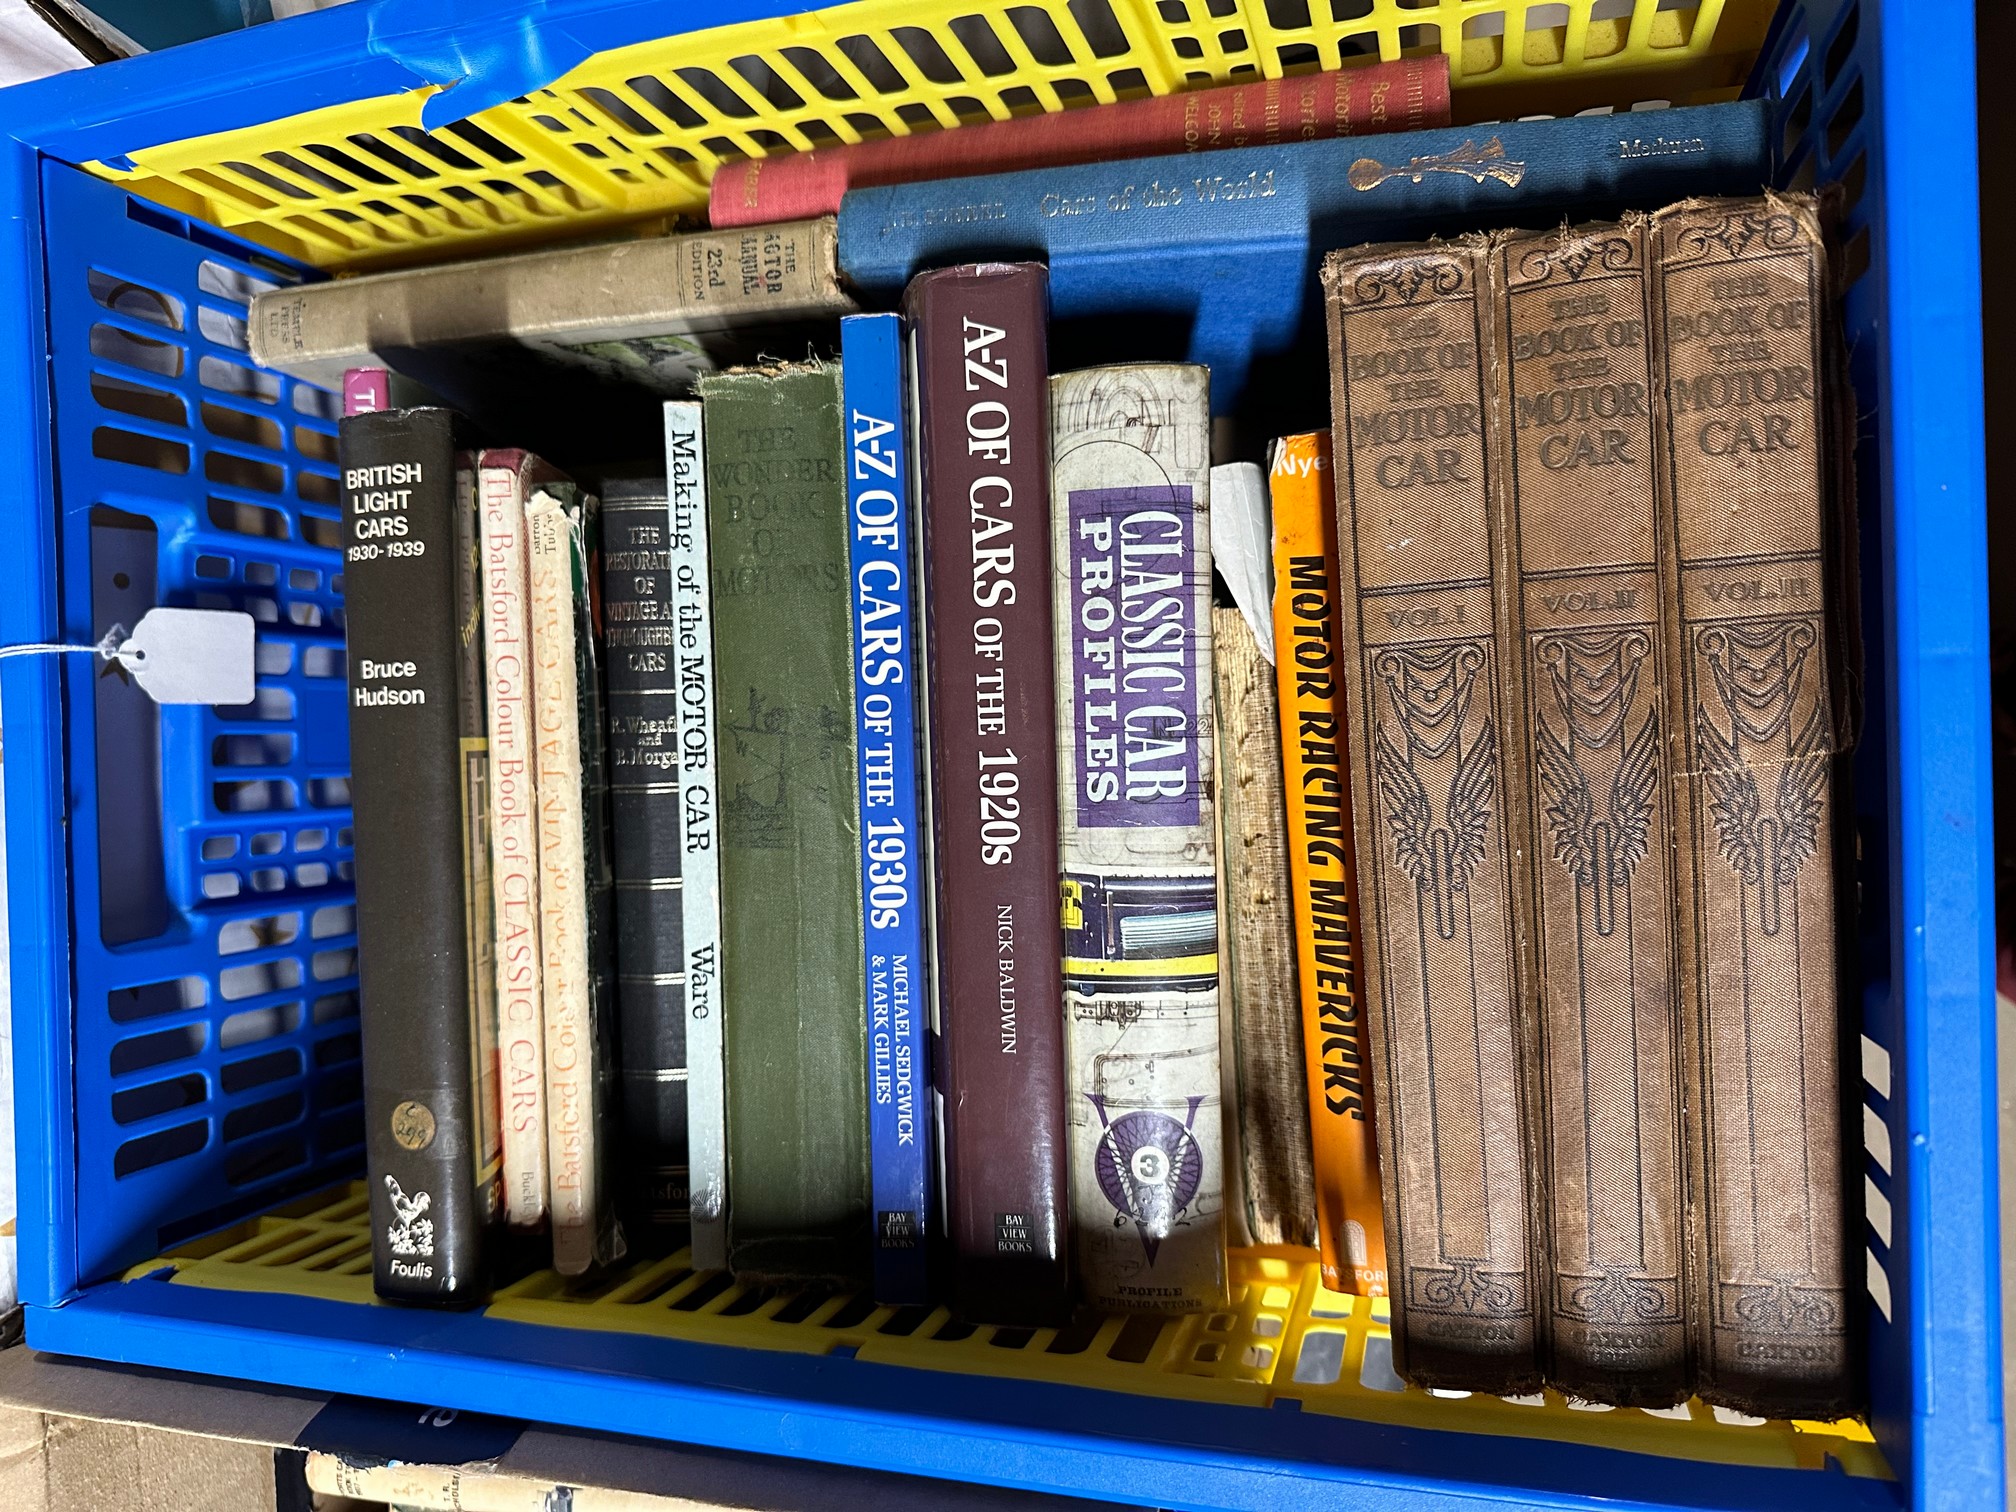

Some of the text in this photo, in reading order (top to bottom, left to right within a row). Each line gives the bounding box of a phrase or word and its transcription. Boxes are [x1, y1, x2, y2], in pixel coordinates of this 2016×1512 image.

[1300, 84, 1316, 141] Storie
[1335, 72, 1353, 137] Motori
[1370, 81, 1390, 126] Best
[1184, 96, 1199, 152] WELCO
[1040, 170, 1276, 219] Cars of the World
[692, 241, 705, 300] EDITION
[707, 249, 725, 288] 23rd
[785, 241, 796, 274] THE
[1711, 274, 1770, 300] THE
[1549, 294, 1609, 322] THE
[1670, 299, 1805, 344] BOOK OF
[1386, 316, 1441, 341] THE
[1515, 318, 1643, 361] BOOK OF
[963, 316, 1008, 391] A-Z
[1351, 340, 1473, 380] BOOK OF
[1549, 356, 1610, 382] THE
[1709, 340, 1773, 365] THE
[1388, 379, 1442, 402] THE
[1518, 382, 1649, 430] MOTOR
[1674, 366, 1814, 414] MOTOR
[737, 427, 796, 454] THE
[853, 408, 896, 480] A-Z
[966, 401, 1011, 465] OF
[1353, 402, 1481, 449] MOTOR
[1699, 413, 1799, 457] CAR
[1276, 454, 1328, 478] Nye
[1376, 447, 1470, 490] CAR
[1539, 428, 1636, 470] CAR
[346, 463, 422, 489] BRITISH
[713, 458, 839, 488] WONDER
[353, 490, 412, 514] LIGHT
[855, 490, 899, 551] OF
[356, 515, 409, 540] CARS
[628, 526, 660, 544] THE
[969, 476, 1017, 608] CARS
[347, 541, 425, 562] 1930-1939
[605, 551, 671, 571] RESTORATI
[634, 576, 655, 594] OF
[670, 430, 710, 853] Making of the MOTOR CAR
[858, 560, 903, 685] CARS
[973, 617, 1003, 662] OF
[361, 659, 417, 680] Bruce
[628, 651, 666, 672] CARS
[1079, 516, 1119, 803] PROFILES
[1118, 511, 1187, 801] CLASSIC CAR
[356, 687, 425, 707] Hudson
[863, 694, 893, 737] OF
[976, 668, 1006, 736] THE
[626, 715, 677, 733] Wheatl
[638, 733, 663, 746] and
[631, 748, 679, 769] Morga
[865, 742, 894, 807] THE
[486, 470, 537, 1133] The Batsford Colour Book of CLASSIC CARS
[1290, 555, 1366, 1121] MOTOR RACING MAVERICKS
[545, 861, 567, 890] of
[691, 942, 714, 1019] Ware
[997, 904, 1017, 1054] NICK BALDWIN
[872, 955, 892, 1105] & MARK GILLIES
[893, 954, 914, 1147] MICHAEL SEDGWICK
[553, 1081, 582, 1191] Batsford
[1139, 1154, 1160, 1178] 3
[560, 1201, 584, 1245] The
[888, 1212, 907, 1224] BAY
[1005, 1214, 1024, 1225] BAY
[998, 1241, 1032, 1252] BOOKS
[390, 1258, 433, 1278] Foulis
[1322, 1264, 1384, 1282] BATSFOR
[1100, 1296, 1202, 1309] PUBLICATIONS
[1118, 1286, 1182, 1297] PROFILE
[1426, 1320, 1515, 1341] CAXTON
[1572, 1329, 1665, 1348] CAXTON
[1737, 1340, 1837, 1362] CAXTON
